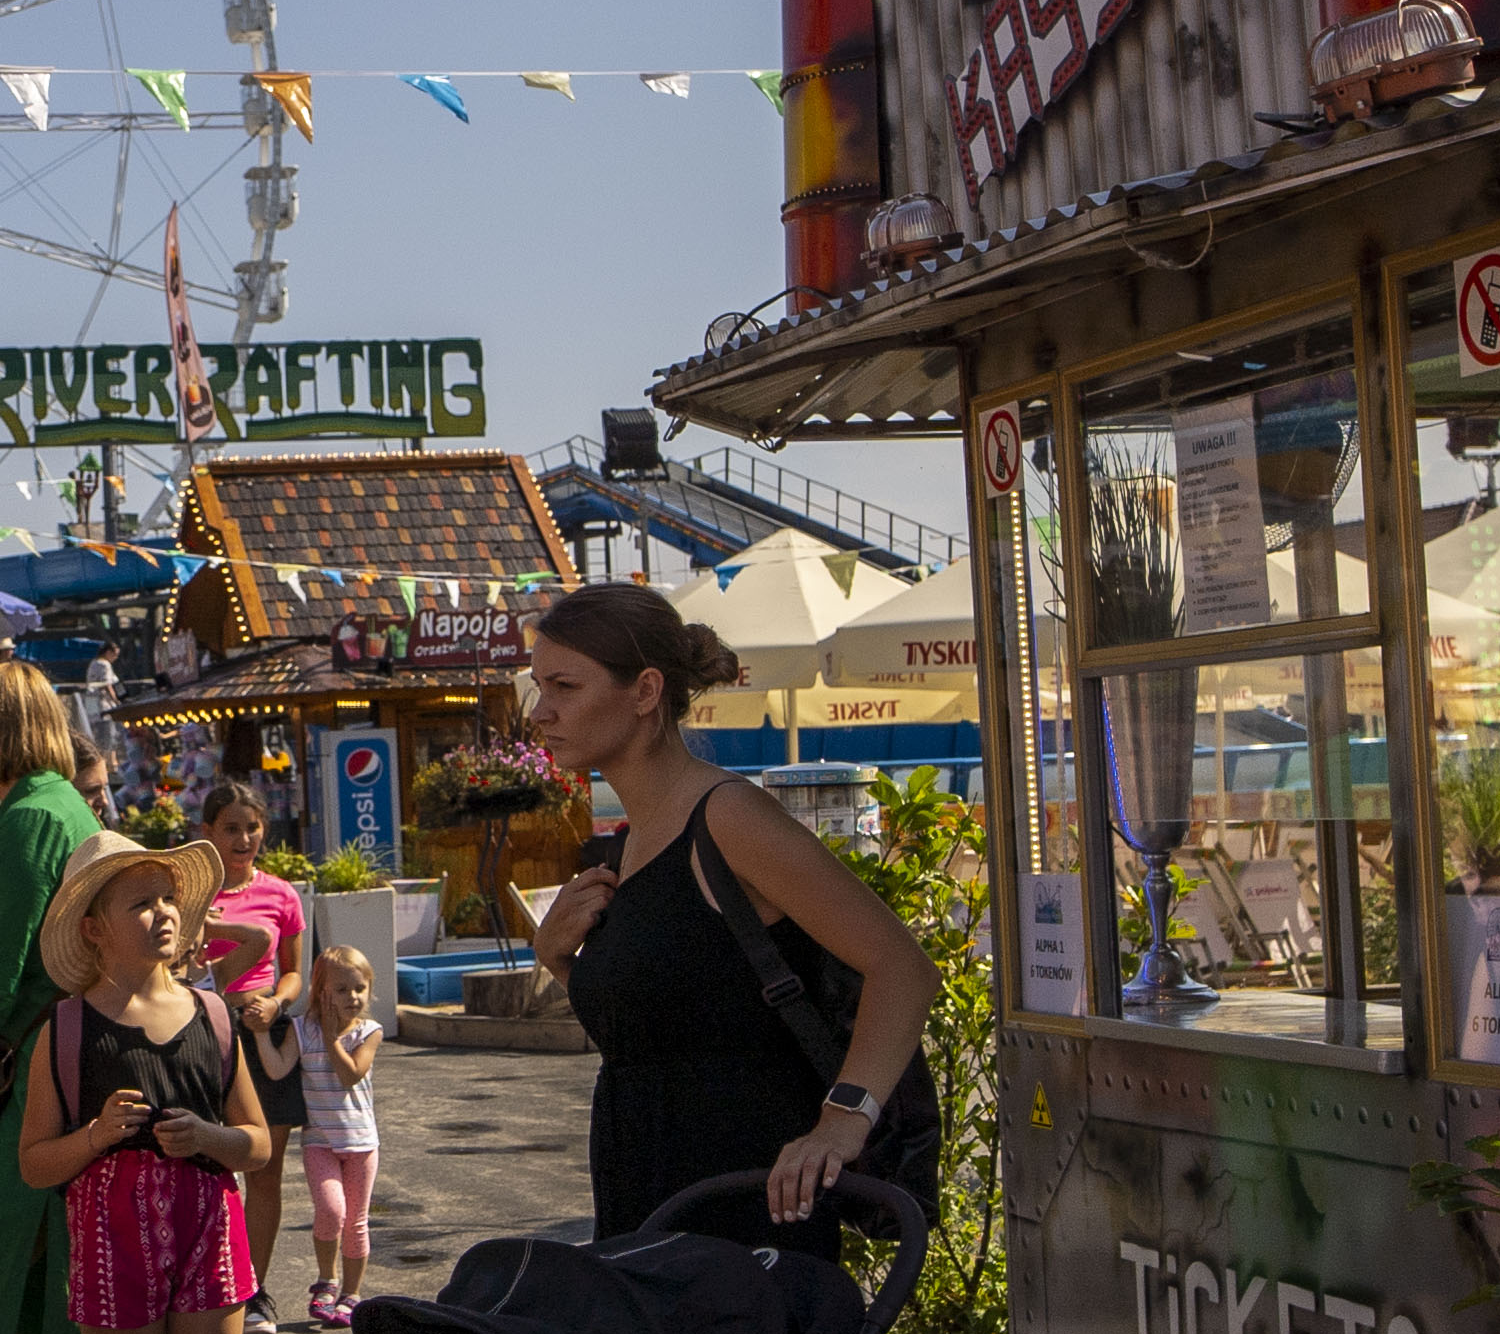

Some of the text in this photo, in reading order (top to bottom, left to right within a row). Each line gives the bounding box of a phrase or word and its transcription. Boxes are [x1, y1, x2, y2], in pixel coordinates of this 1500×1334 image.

[1191, 434, 1225, 455] UWAGA
[420, 609, 509, 641] Napoje
[490, 643, 518, 660] piwo
[902, 640, 977, 667] TYSKI
[1035, 938, 1065, 954] ALPHA 1
[1030, 964, 1072, 981] 6 TOKENÓW
[1472, 1015, 1479, 1032] 6
